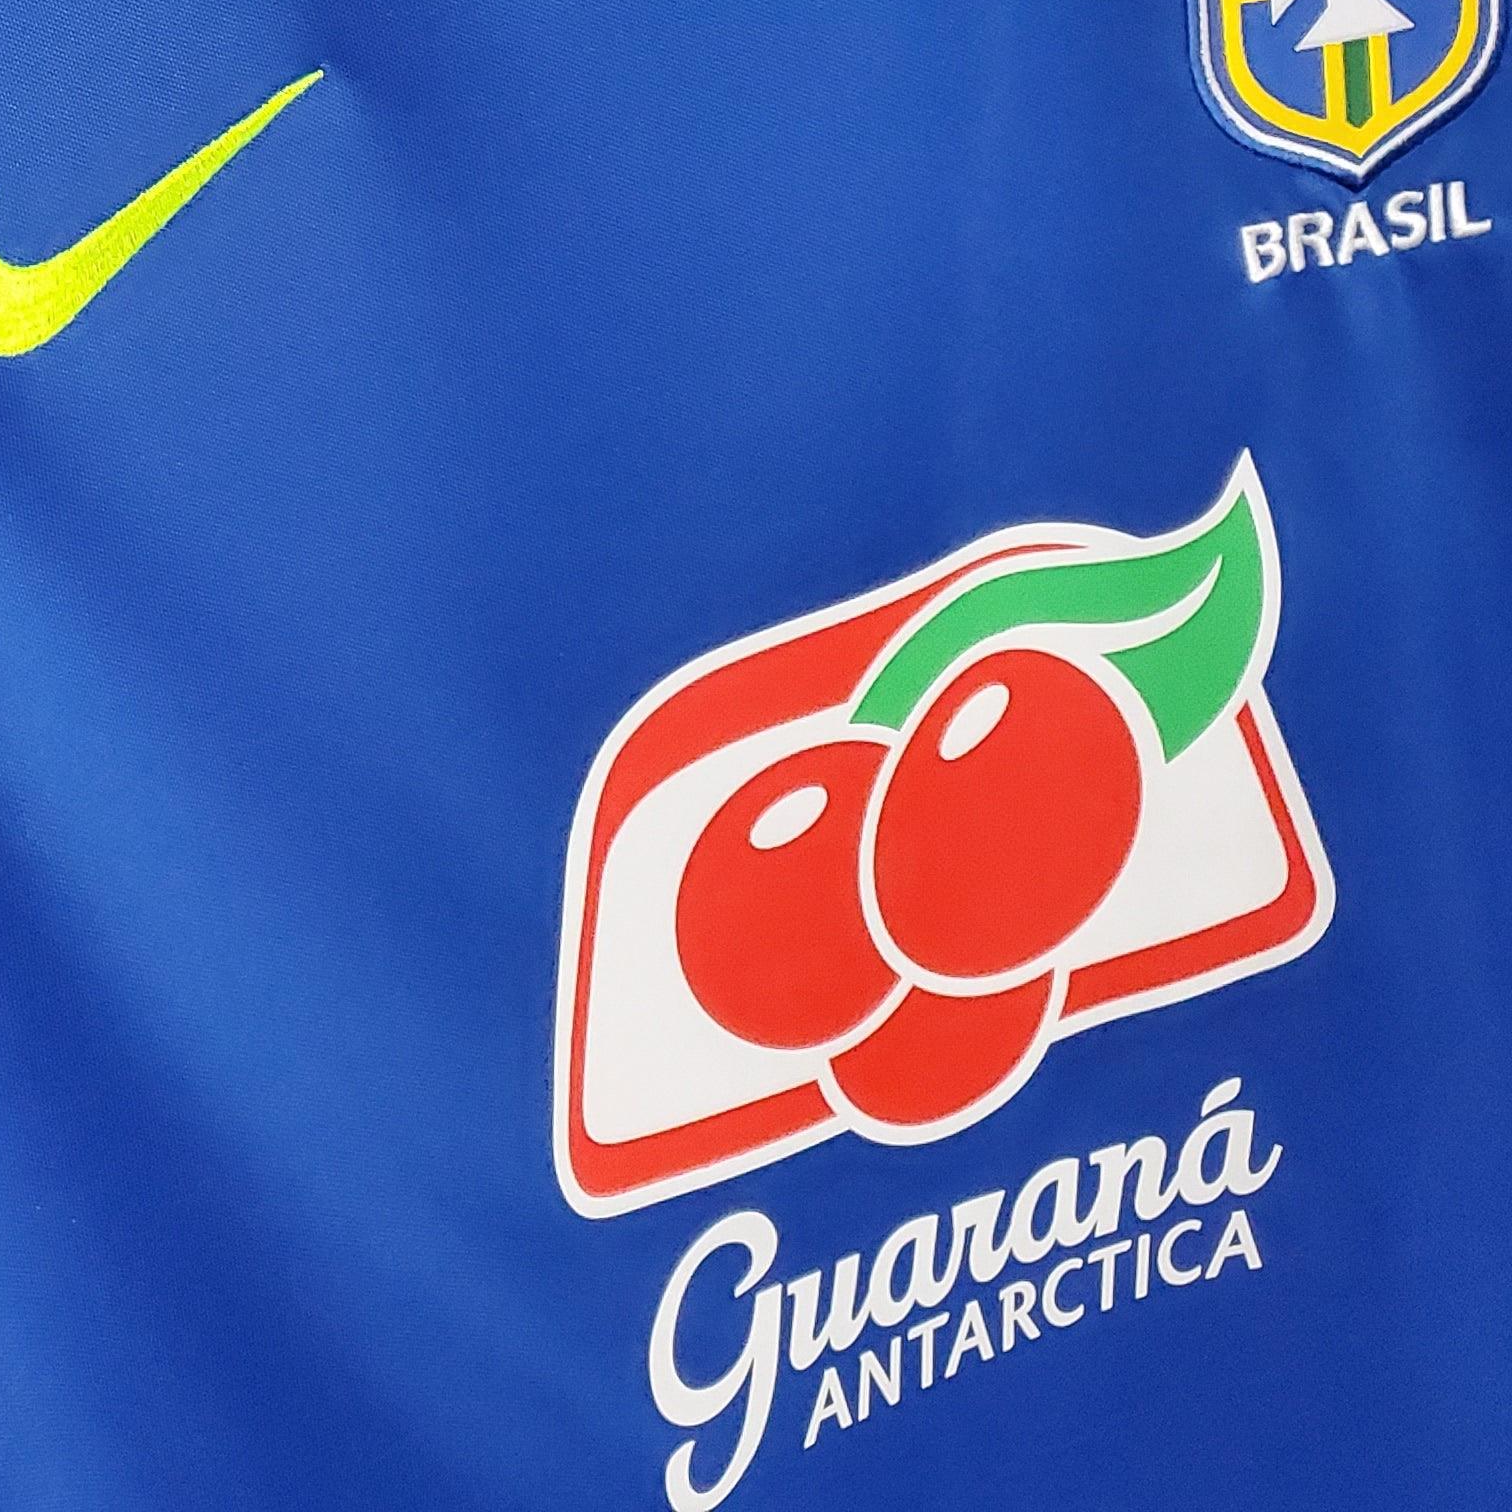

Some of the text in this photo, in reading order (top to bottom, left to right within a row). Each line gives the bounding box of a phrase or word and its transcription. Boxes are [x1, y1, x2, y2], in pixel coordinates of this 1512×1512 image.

[1240, 180, 1493, 285] BRASIL
[649, 1077, 1283, 1512] Guaraná
[803, 1209, 1263, 1450] ANTARCTICA
